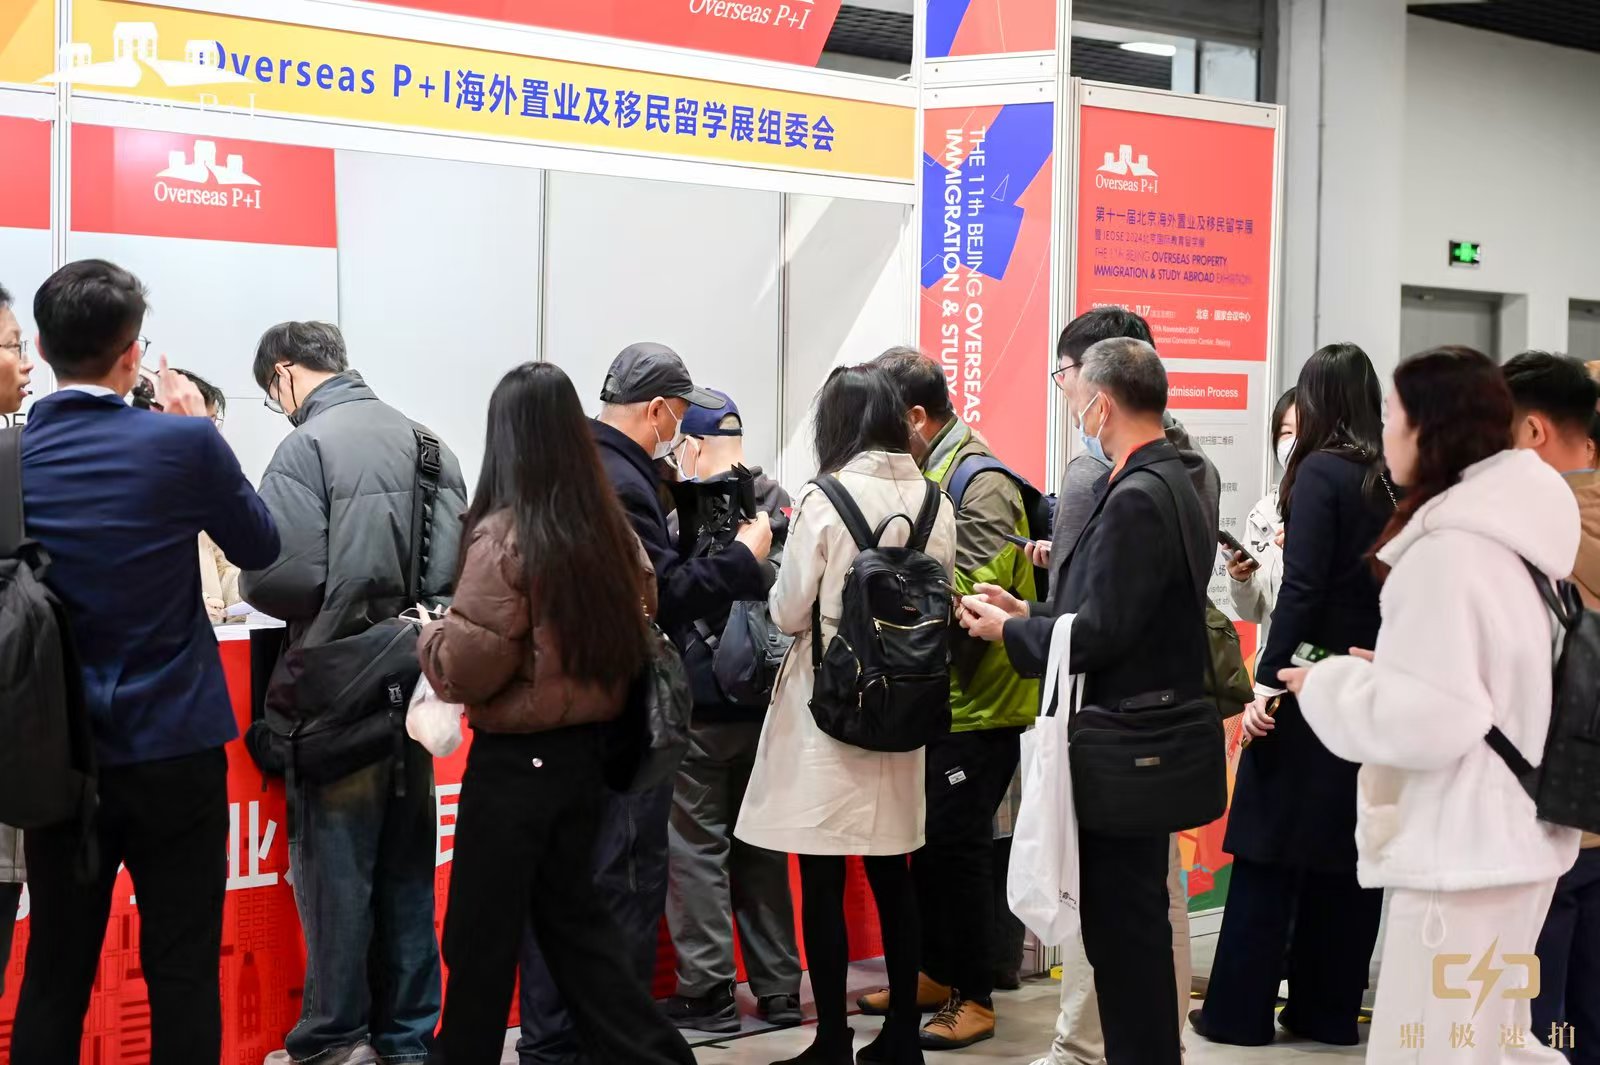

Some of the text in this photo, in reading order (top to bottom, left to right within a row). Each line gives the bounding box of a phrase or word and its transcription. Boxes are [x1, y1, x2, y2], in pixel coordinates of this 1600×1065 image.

[689, 0, 811, 30] Overseas P+I
[969, 126, 985, 167] THE
[154, 182, 262, 210] Overseas P+I
[968, 174, 985, 217] 11th
[1095, 174, 1158, 194] Overseas P+I
[943, 129, 963, 292] IMMIGRATION
[1152, 251, 1190, 265] OVERSEAS
[1192, 255, 1228, 268] PROPERTY
[1094, 265, 1148, 279] IMMIGRATION
[1150, 269, 1156, 279] &
[1158, 269, 1180, 281] STUDY
[1183, 273, 1215, 283] ABROAD
[941, 300, 960, 317] &
[963, 303, 983, 423] OVERSEAS
[1207, 386, 1239, 398] Process
